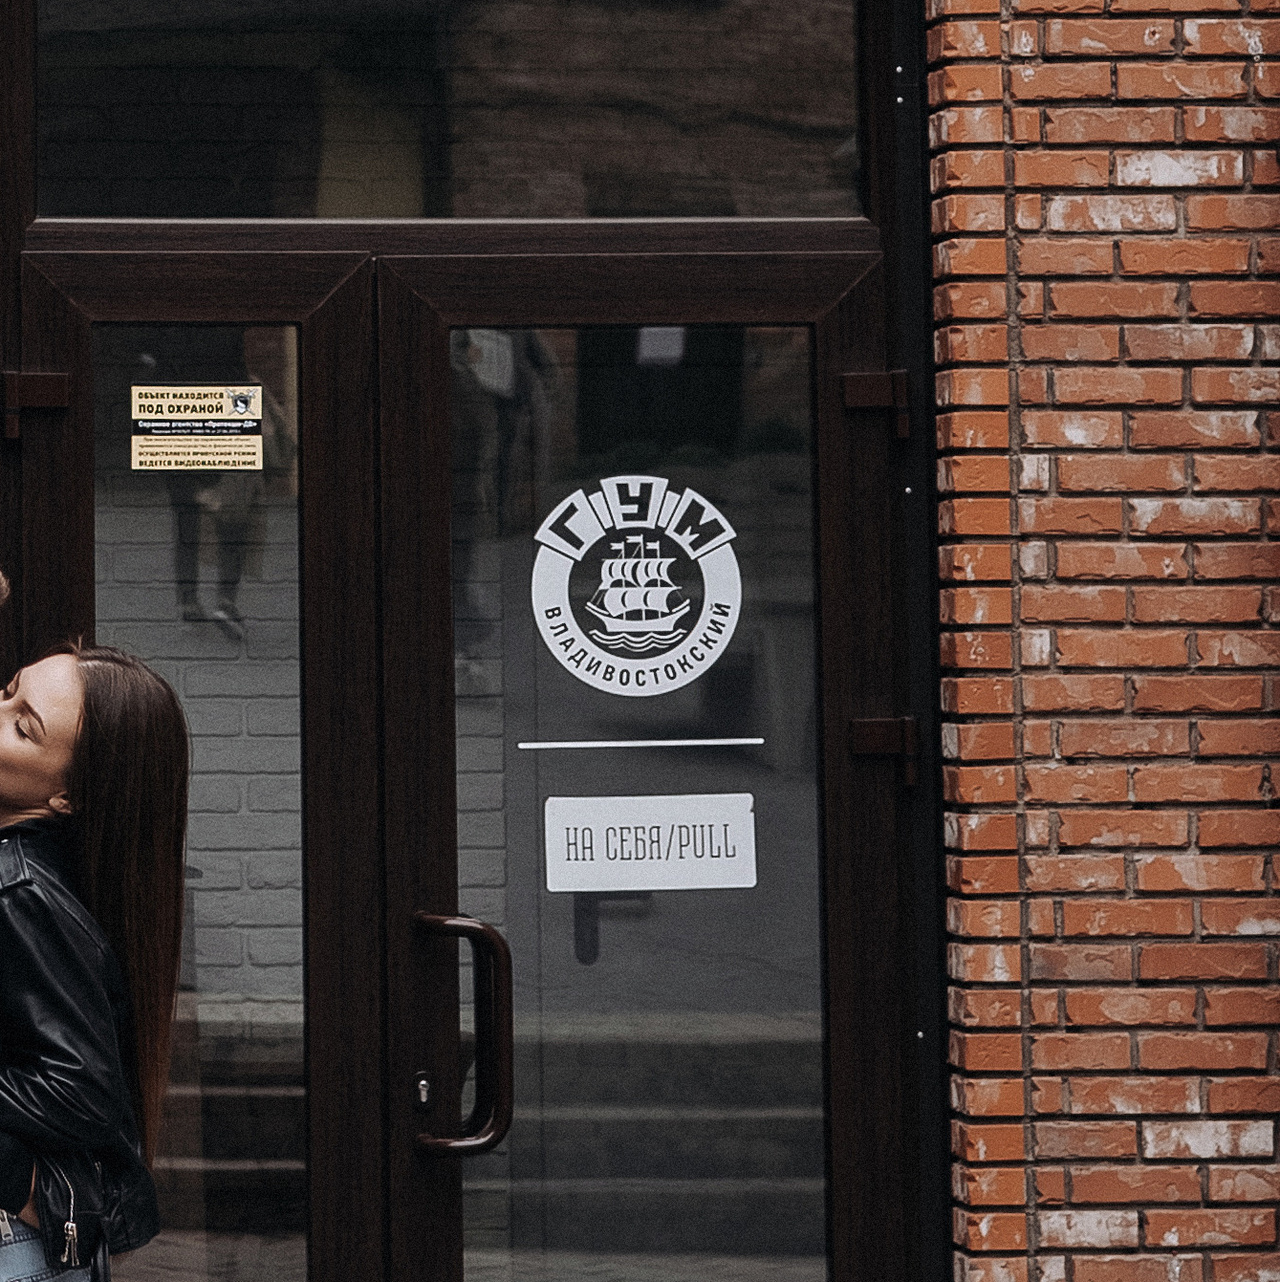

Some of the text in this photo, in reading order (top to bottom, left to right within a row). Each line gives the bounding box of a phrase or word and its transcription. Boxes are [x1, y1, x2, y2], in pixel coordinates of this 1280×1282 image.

[138, 402, 224, 415] ПОД ОХРАНОЙ
[172, 392, 224, 400] НАХОДИТСЯ
[547, 481, 727, 555] ГУМ
[545, 602, 731, 687] ВЛАДИВОСТОКСКИЙ
[565, 823, 737, 862] НА СЕБЯ/PULL
